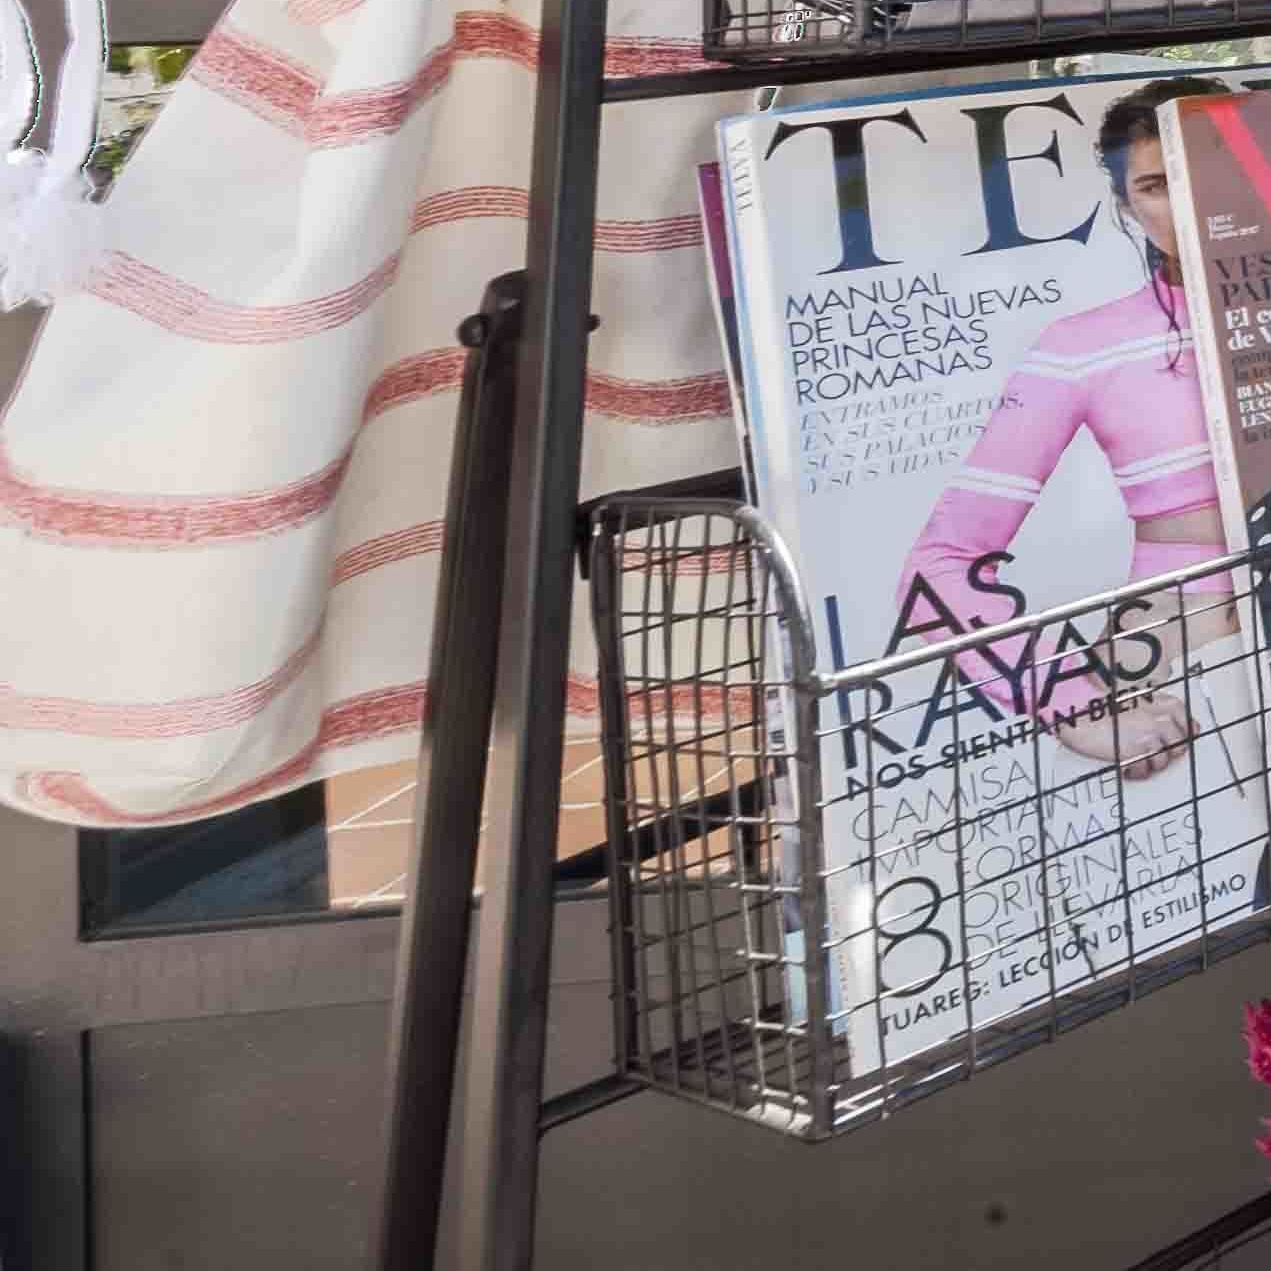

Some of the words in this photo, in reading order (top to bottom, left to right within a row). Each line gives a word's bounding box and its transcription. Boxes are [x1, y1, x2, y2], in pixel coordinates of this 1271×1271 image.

[786, 272, 949, 319] MANUAL
[789, 316, 834, 348] DE
[848, 304, 911, 337] LAS
[922, 279, 1062, 325] NUEVAS
[1225, 306, 1250, 330] El
[792, 319, 989, 376] PRINCESAS
[1227, 329, 1255, 352] de
[795, 345, 993, 406] ROMANAS
[838, 599, 1163, 770] RAYAS
[940, 704, 1080, 769] SIENTAN
[1088, 682, 1155, 723] BIEN
[853, 759, 1034, 842] CAMISA
[856, 777, 1119, 880] IMPORTANTE
[962, 812, 1203, 929] ORIGINALES
[1142, 873, 1247, 929] ESTILISMO
[876, 875, 953, 998] 8
